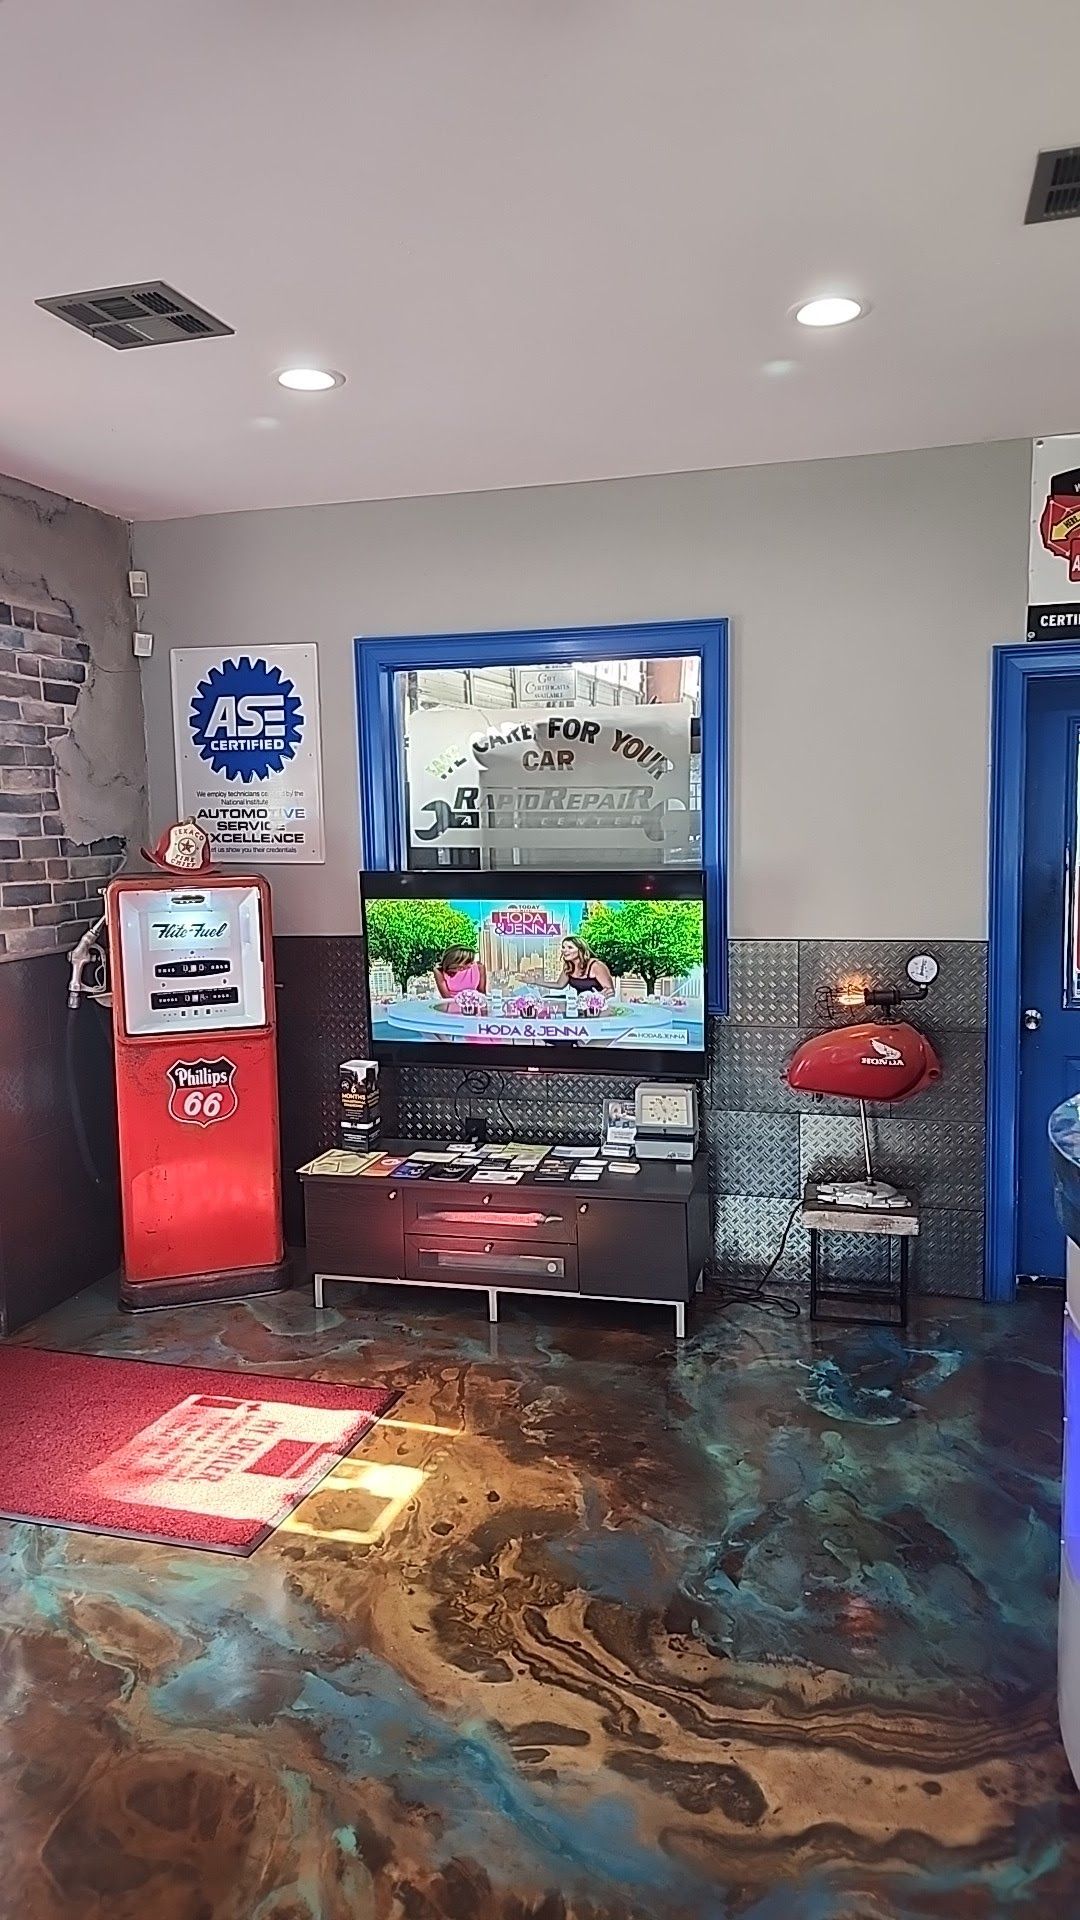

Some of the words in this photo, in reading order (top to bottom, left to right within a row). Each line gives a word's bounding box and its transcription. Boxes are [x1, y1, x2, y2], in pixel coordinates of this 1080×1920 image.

[1040, 613, 1080, 627] CERTI
[204, 694, 286, 738] ASE
[210, 739, 285, 751] CERTIFIED
[548, 717, 601, 744] FOR
[611, 729, 671, 780] YOUR
[522, 750, 575, 771] CAR
[174, 828, 205, 842] TEXACO
[206, 833, 304, 844] XCELLENCE
[170, 858, 196, 868] CHIEF
[175, 854, 195, 862] FIRE
[499, 912, 544, 924] HODA
[152, 922, 229, 939] Flite-Fuel
[478, 1023, 521, 1036] HODA
[524, 1024, 536, 1037] &
[537, 1025, 589, 1037] JENNA
[860, 1057, 905, 1066] HONDA
[174, 1067, 229, 1088] Phillips
[350, 1085, 357, 1093] 6
[183, 1091, 223, 1117] 66
